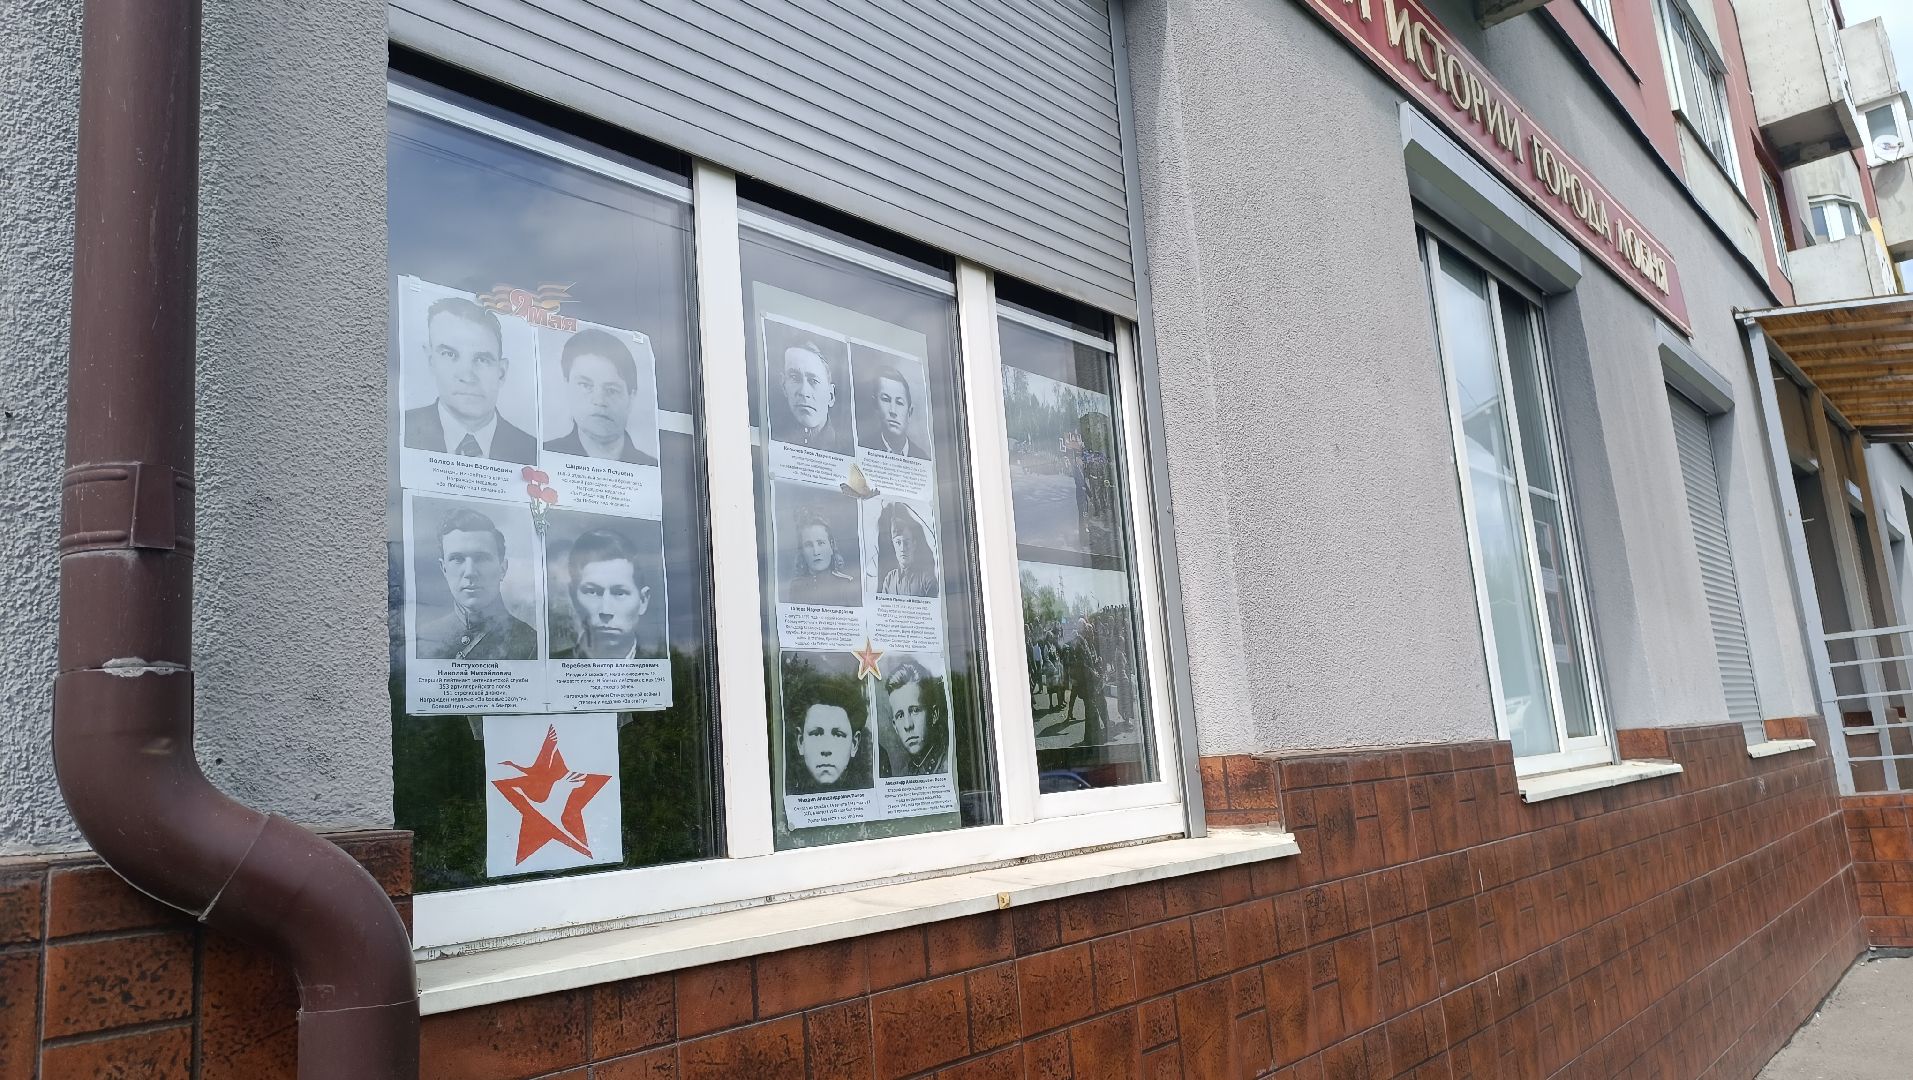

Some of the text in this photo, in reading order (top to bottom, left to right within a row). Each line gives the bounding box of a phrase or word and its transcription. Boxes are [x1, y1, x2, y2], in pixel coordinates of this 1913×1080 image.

[1384, 0, 1670, 296] ИСТОРИИ ГОРОДА ЛОБНЯ
